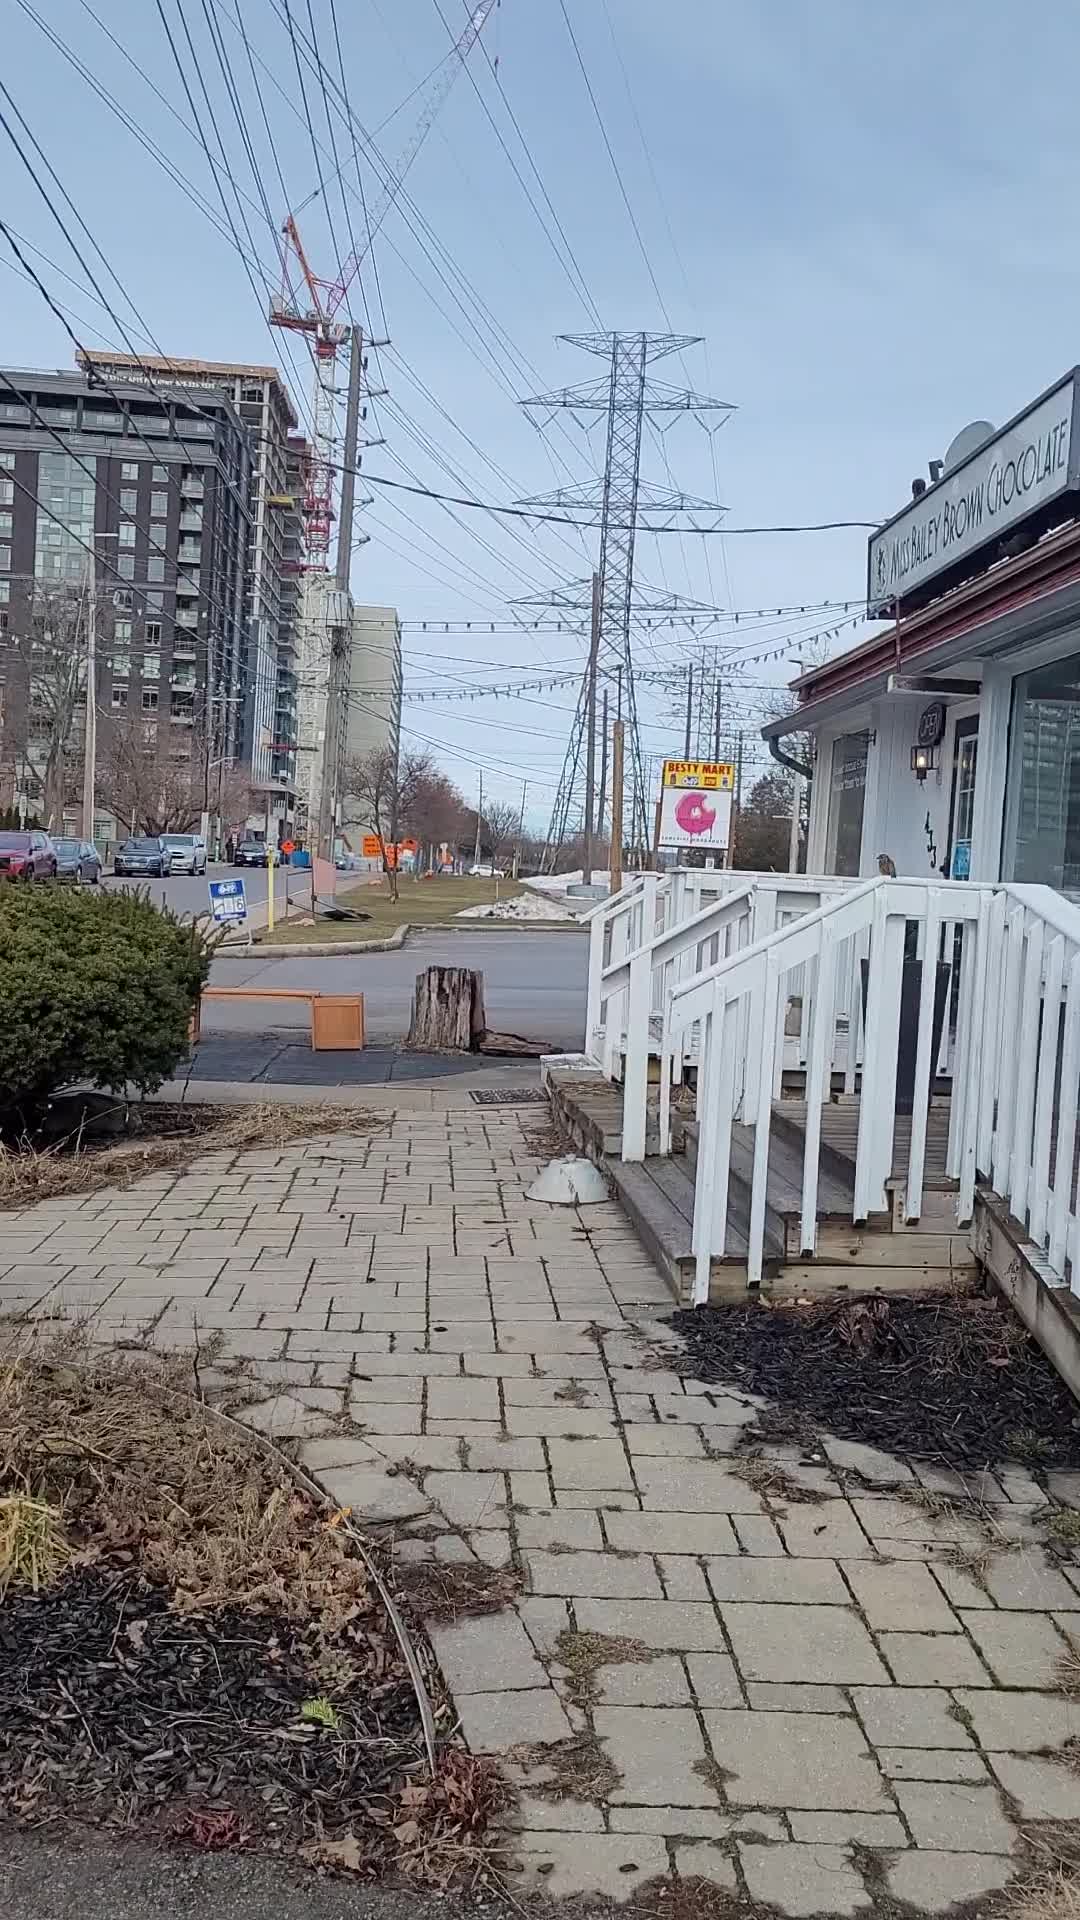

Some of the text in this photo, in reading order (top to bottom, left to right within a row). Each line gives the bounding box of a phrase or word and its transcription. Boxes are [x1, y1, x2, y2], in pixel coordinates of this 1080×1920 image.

[890, 418, 1068, 584] MISS BAILEY BROWN CHOCOLATE
[668, 762, 731, 775] BESTY MART
